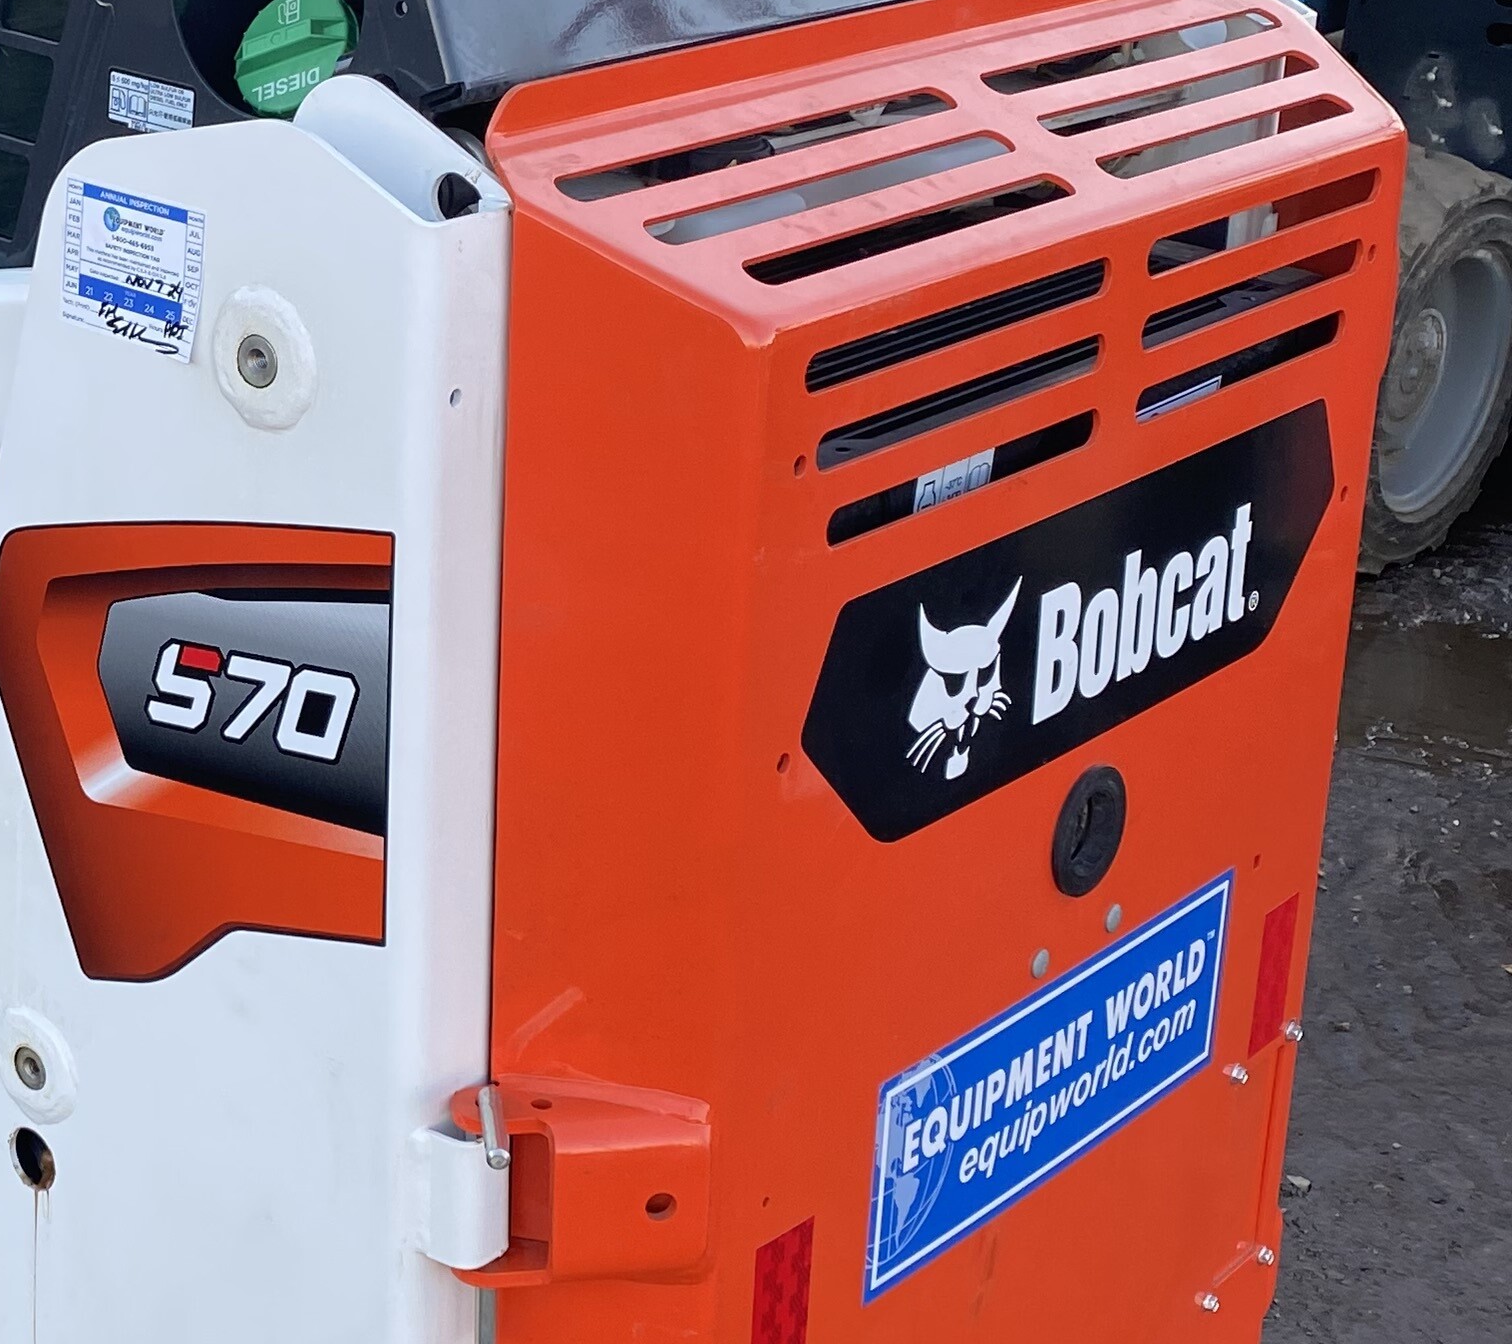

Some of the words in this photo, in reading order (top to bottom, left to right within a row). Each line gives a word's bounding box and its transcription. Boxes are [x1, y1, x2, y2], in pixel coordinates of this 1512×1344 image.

[252, 67, 320, 102] DIESEL
[70, 197, 81, 206] JAN
[100, 191, 128, 204] ANNUAL
[129, 197, 170, 216] INSPECTION
[69, 214, 80, 223] FEB
[68, 231, 80, 239] MAR
[189, 230, 201, 240] JUL
[188, 247, 200, 256] AUG
[66, 263, 78, 272] MAY
[187, 265, 199, 273] SEP
[65, 280, 77, 289] JUN
[185, 281, 198, 290] OCT
[85, 285, 94, 295] 21
[104, 291, 114, 302] 22
[124, 298, 134, 308] 23
[144, 304, 155, 314] 24
[165, 309, 175, 321] 25
[1032, 502, 1253, 725] Bobcat
[145, 639, 359, 764] S70
[902, 1010, 1093, 1174] EQUIPMENT
[958, 998, 1197, 1184] equipworld.com
